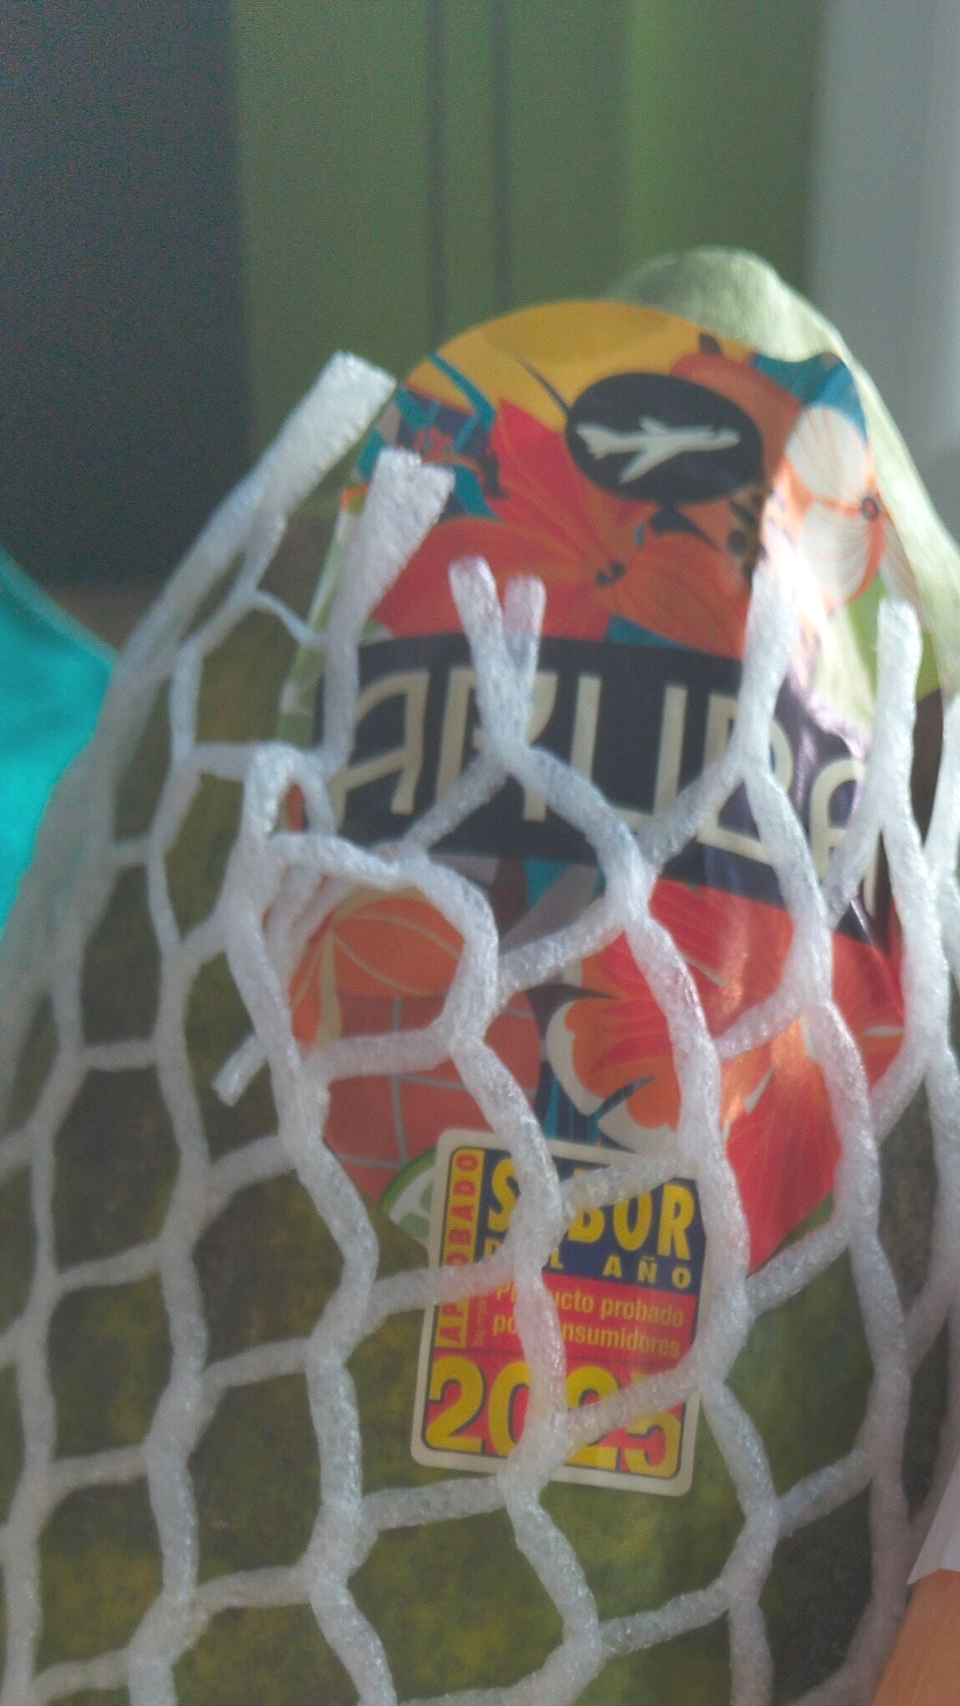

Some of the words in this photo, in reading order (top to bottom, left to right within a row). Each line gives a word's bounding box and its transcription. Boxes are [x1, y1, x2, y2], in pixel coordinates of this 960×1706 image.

[489, 1157, 696, 1261] SBOR
[437, 1153, 478, 1348] APOBADO
[603, 1253, 691, 1290] AÑO
[600, 1300, 684, 1328] probado
